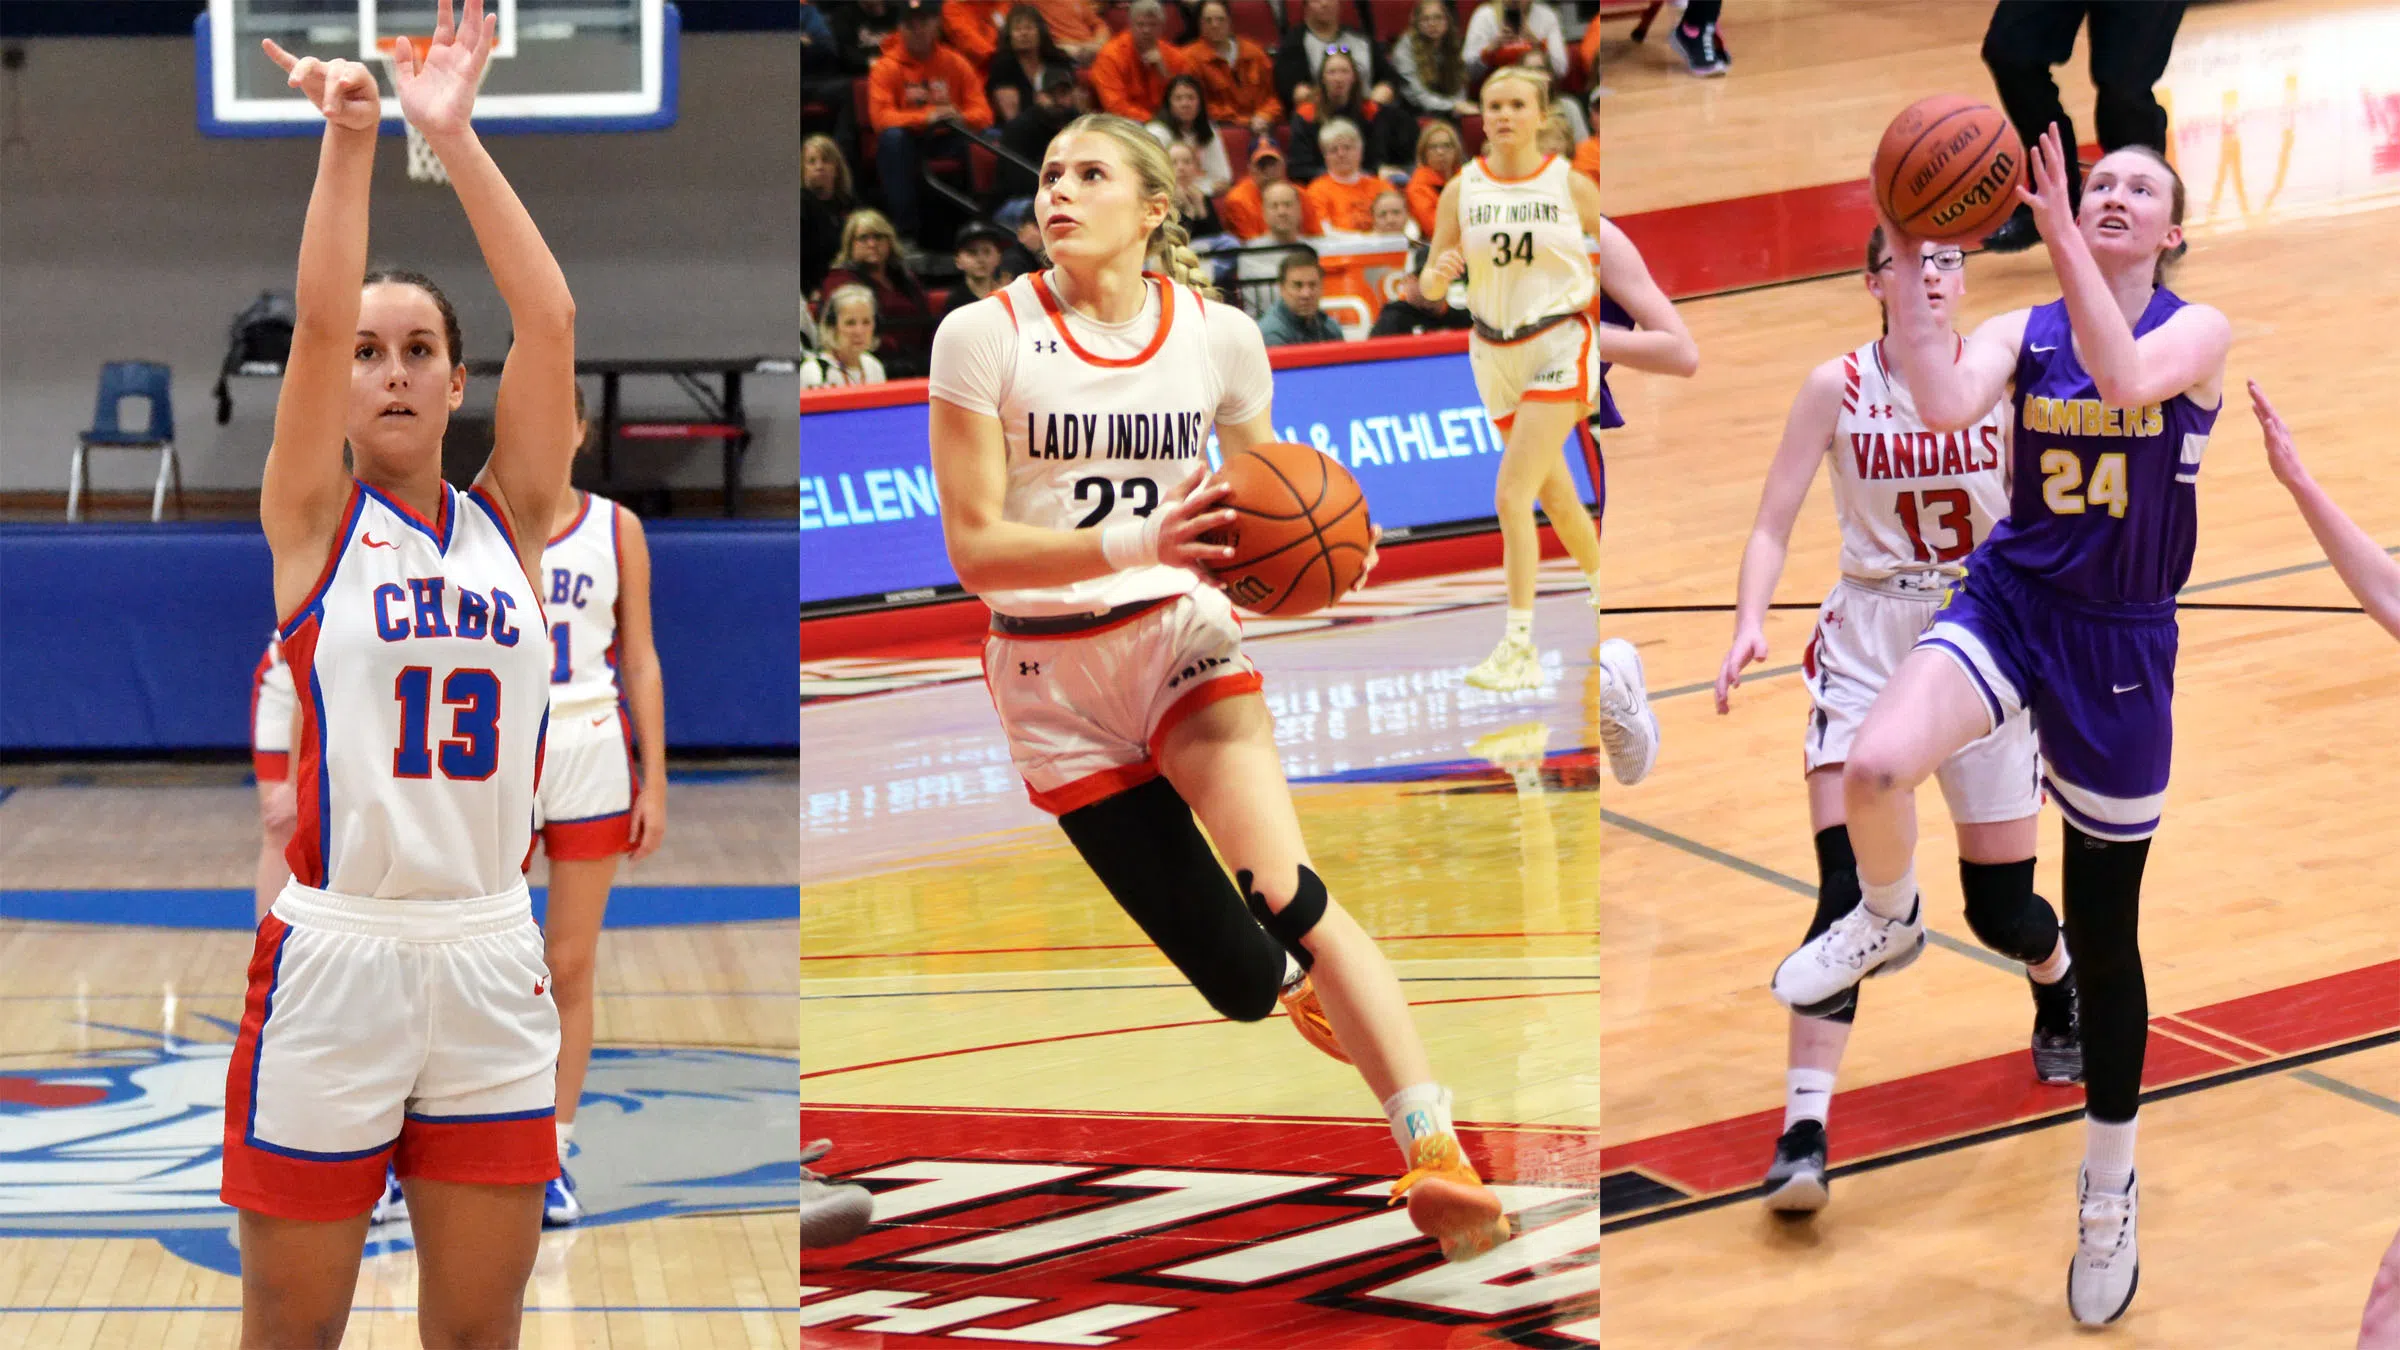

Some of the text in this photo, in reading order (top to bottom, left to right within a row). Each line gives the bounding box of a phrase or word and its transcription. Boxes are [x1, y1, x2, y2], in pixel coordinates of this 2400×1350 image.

[1469, 201, 1558, 226] LADY INDIANS
[1932, 151, 2015, 226] Wilson
[1490, 231, 1534, 267] 34
[1027, 412, 1097, 461] LADY
[1105, 411, 1202, 461] INDIANS
[1350, 405, 1504, 468] ATHLETI
[1850, 425, 1998, 480] VANDALS
[799, 463, 941, 531] ELLEN
[2040, 448, 2129, 519] 24
[1894, 488, 1975, 564] 13
[373, 576, 520, 648] CHBC
[549, 567, 594, 610] BC
[393, 665, 502, 782] 13
